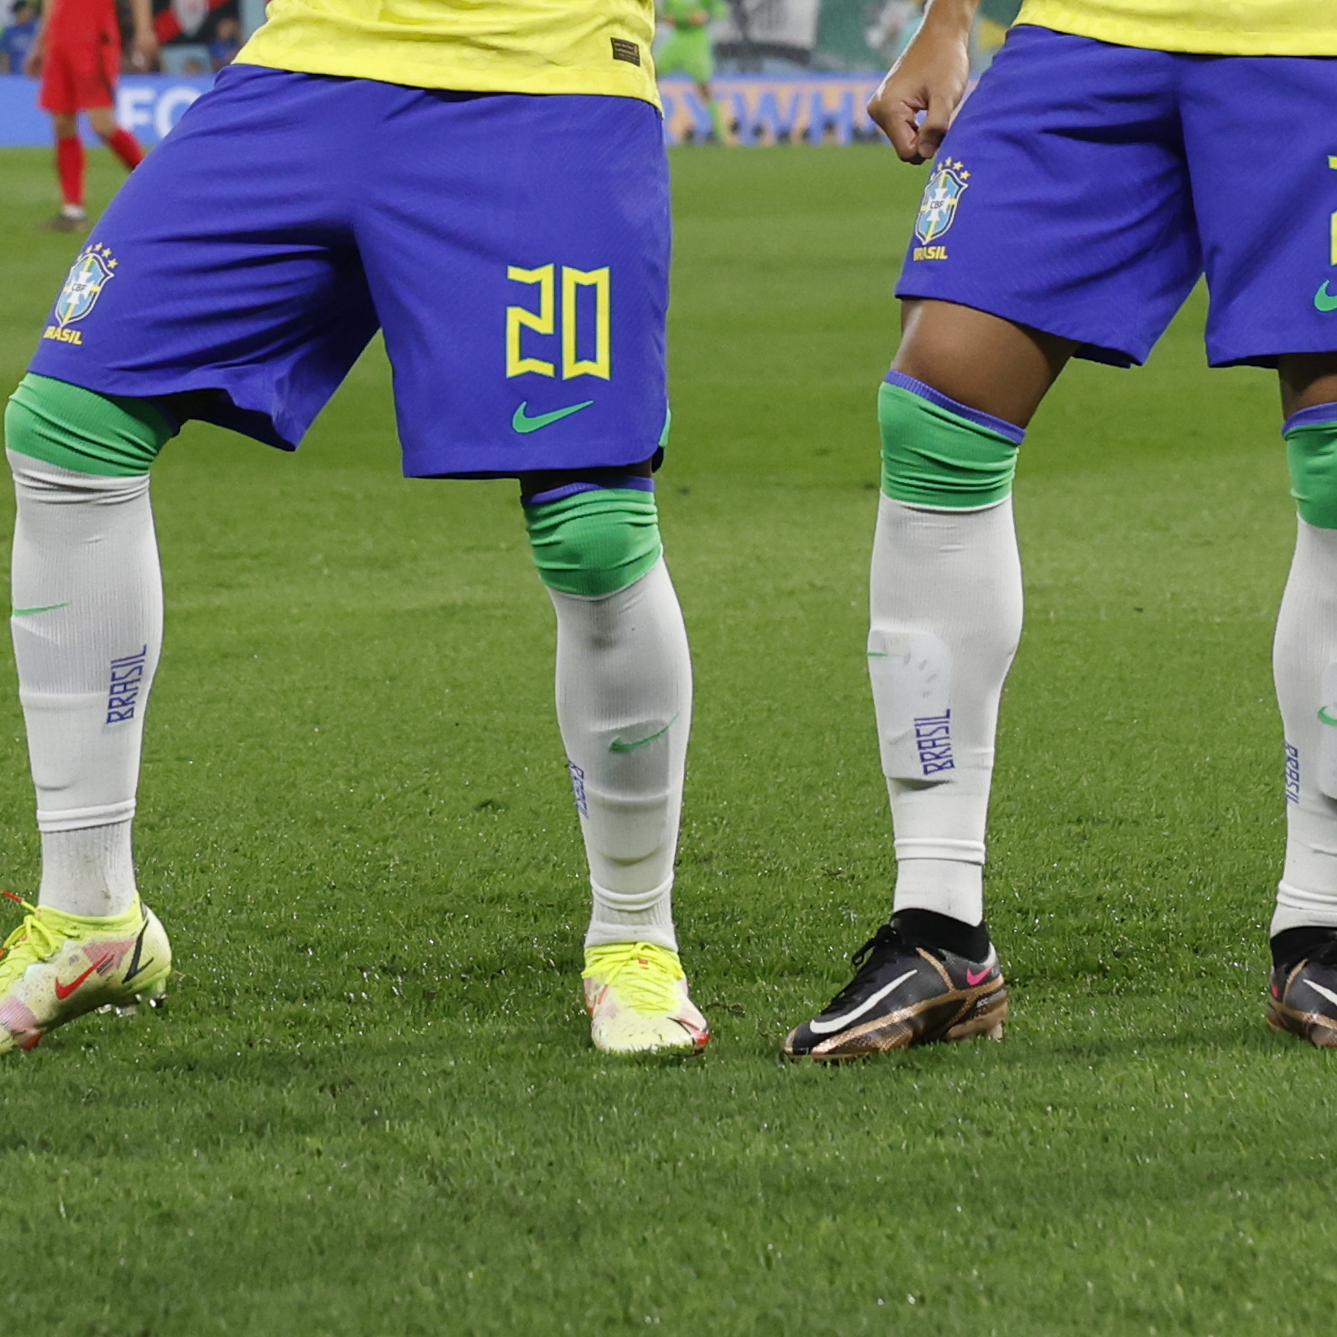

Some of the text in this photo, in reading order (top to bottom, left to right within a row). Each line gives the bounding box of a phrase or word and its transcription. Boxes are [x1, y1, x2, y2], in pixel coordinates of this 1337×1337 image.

[504, 263, 611, 381] 20
[106, 643, 147, 724] BRASIL
[913, 708, 956, 776] BRASIL
